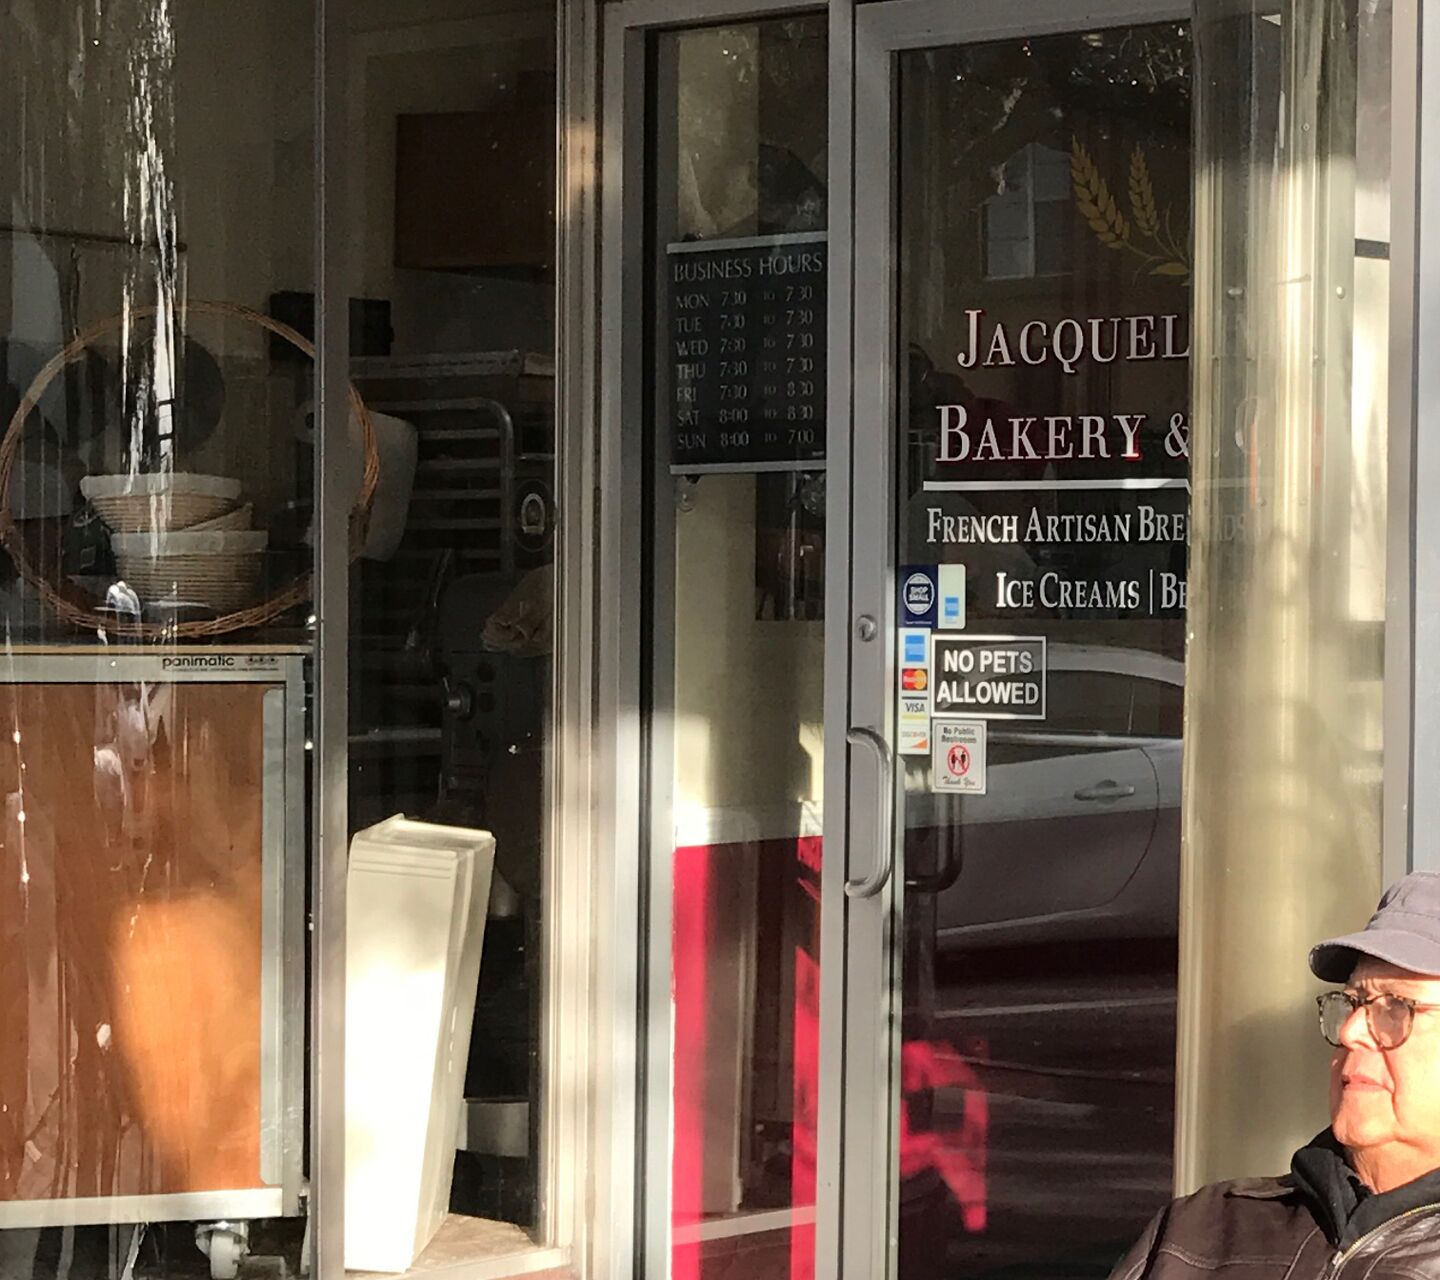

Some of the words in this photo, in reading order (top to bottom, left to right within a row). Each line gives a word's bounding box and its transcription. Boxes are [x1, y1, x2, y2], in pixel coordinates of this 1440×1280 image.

[674, 258, 752, 282] BUSINESS
[759, 253, 823, 276] HOURS
[675, 292, 710, 310] MON
[676, 317, 702, 333] TUE
[676, 339, 709, 356] WED
[676, 363, 706, 379] THU
[676, 387, 697, 402] FRI
[677, 411, 700, 426] SAT
[936, 404, 1147, 461] BAKERY
[677, 434, 706, 449] SUN
[926, 507, 1019, 543] FRENCH
[1024, 506, 1132, 542] ARTISAN
[996, 572, 1034, 609] ICE
[1039, 572, 1140, 609] CREAMS
[162, 655, 235, 670] panimatic
[944, 649, 974, 673] NO
[980, 650, 1032, 673] PETS
[937, 681, 1039, 704] ALLOWED
[905, 703, 925, 712] VISA
